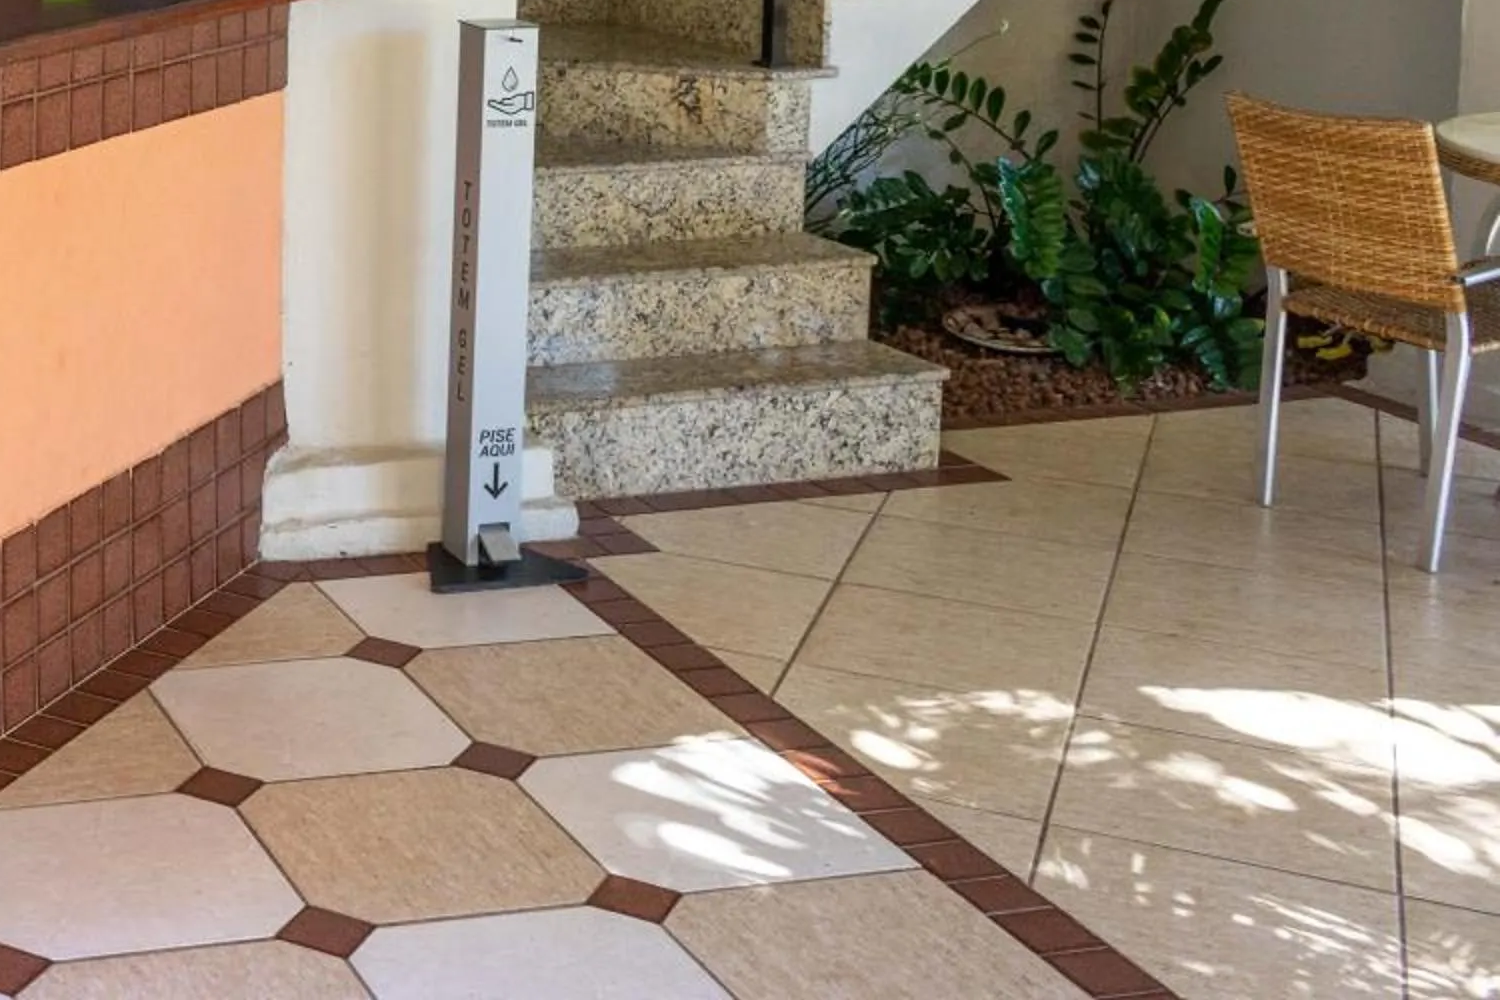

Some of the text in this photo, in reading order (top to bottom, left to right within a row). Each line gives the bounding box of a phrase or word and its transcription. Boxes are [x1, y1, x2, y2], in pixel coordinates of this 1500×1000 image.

[456, 180, 472, 403] TOTEM GEL
[479, 427, 516, 444] PISE
[479, 443, 515, 458] AQUI
